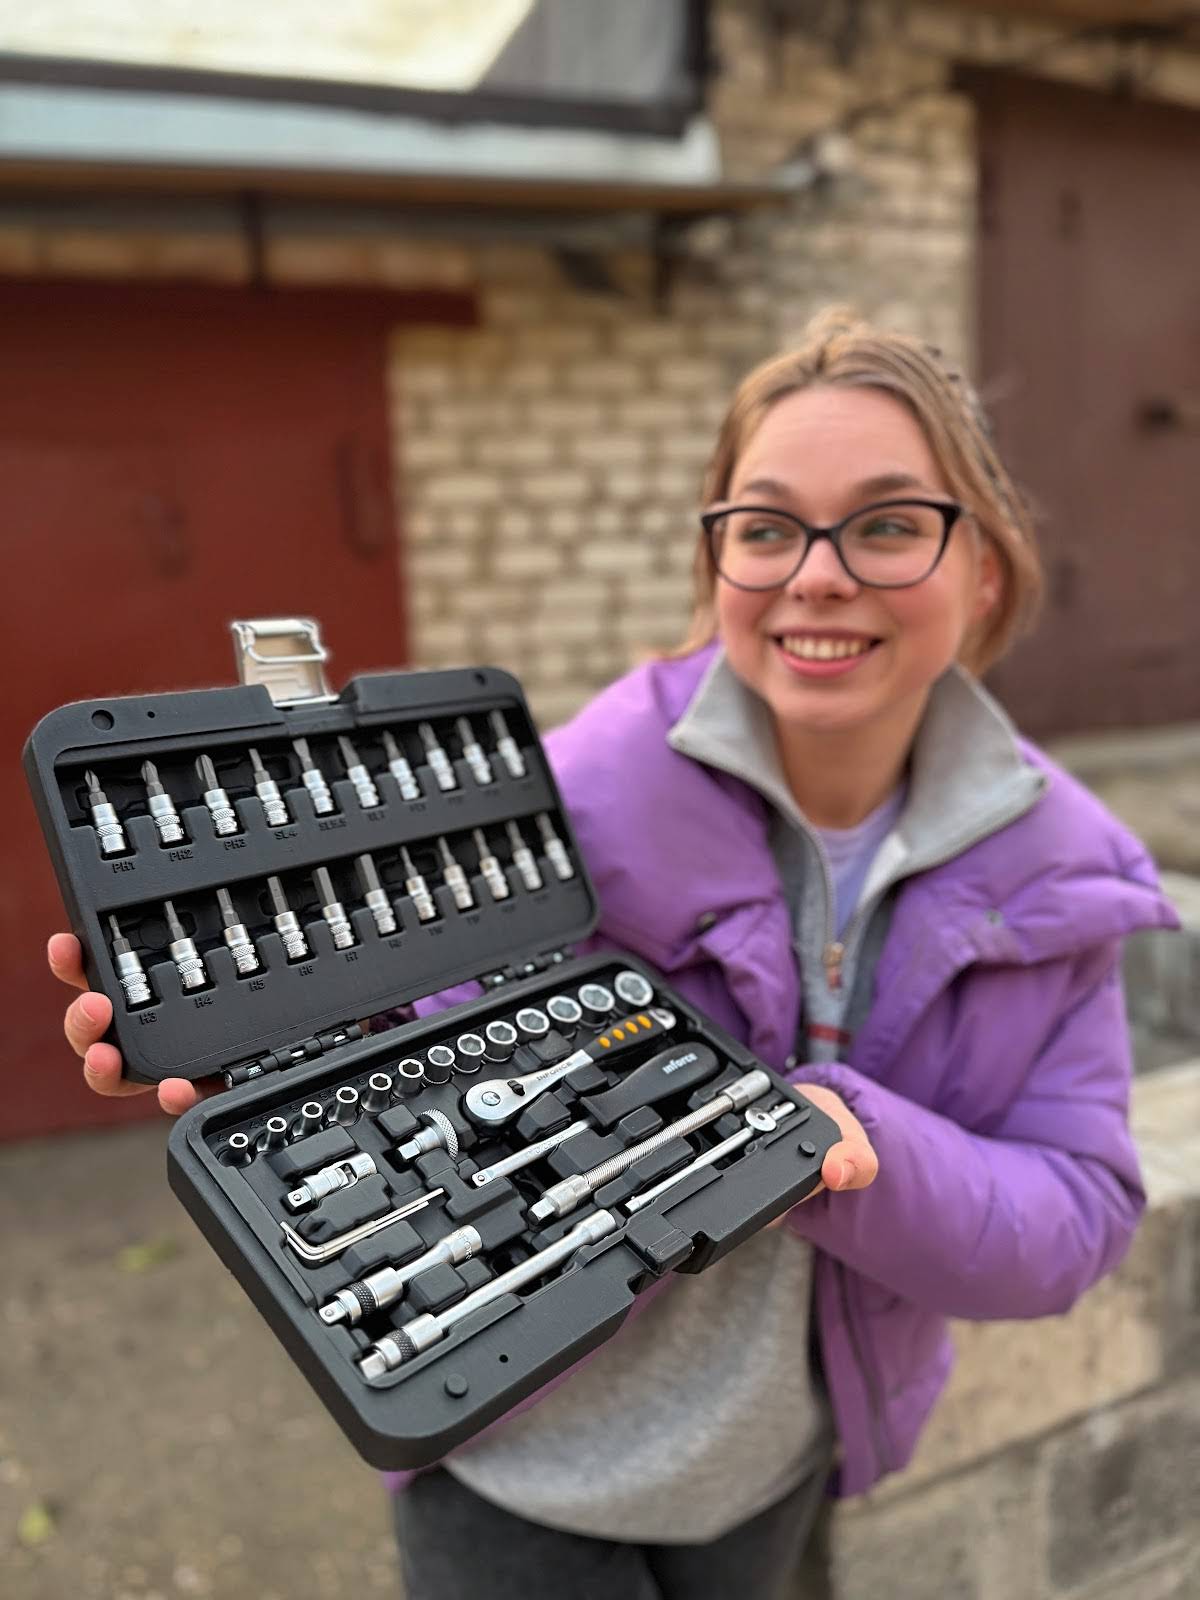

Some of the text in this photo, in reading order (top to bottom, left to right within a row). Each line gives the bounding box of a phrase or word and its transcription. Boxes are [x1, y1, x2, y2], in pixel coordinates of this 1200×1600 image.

[275, 830, 298, 840] SL4
[224, 838, 247, 850] PH3
[169, 849, 194, 862] PH2
[112, 861, 136, 873] PH1
[298, 964, 314, 977] H6
[249, 979, 266, 992] H5
[194, 997, 214, 1009] H4
[139, 1012, 158, 1025] H3
